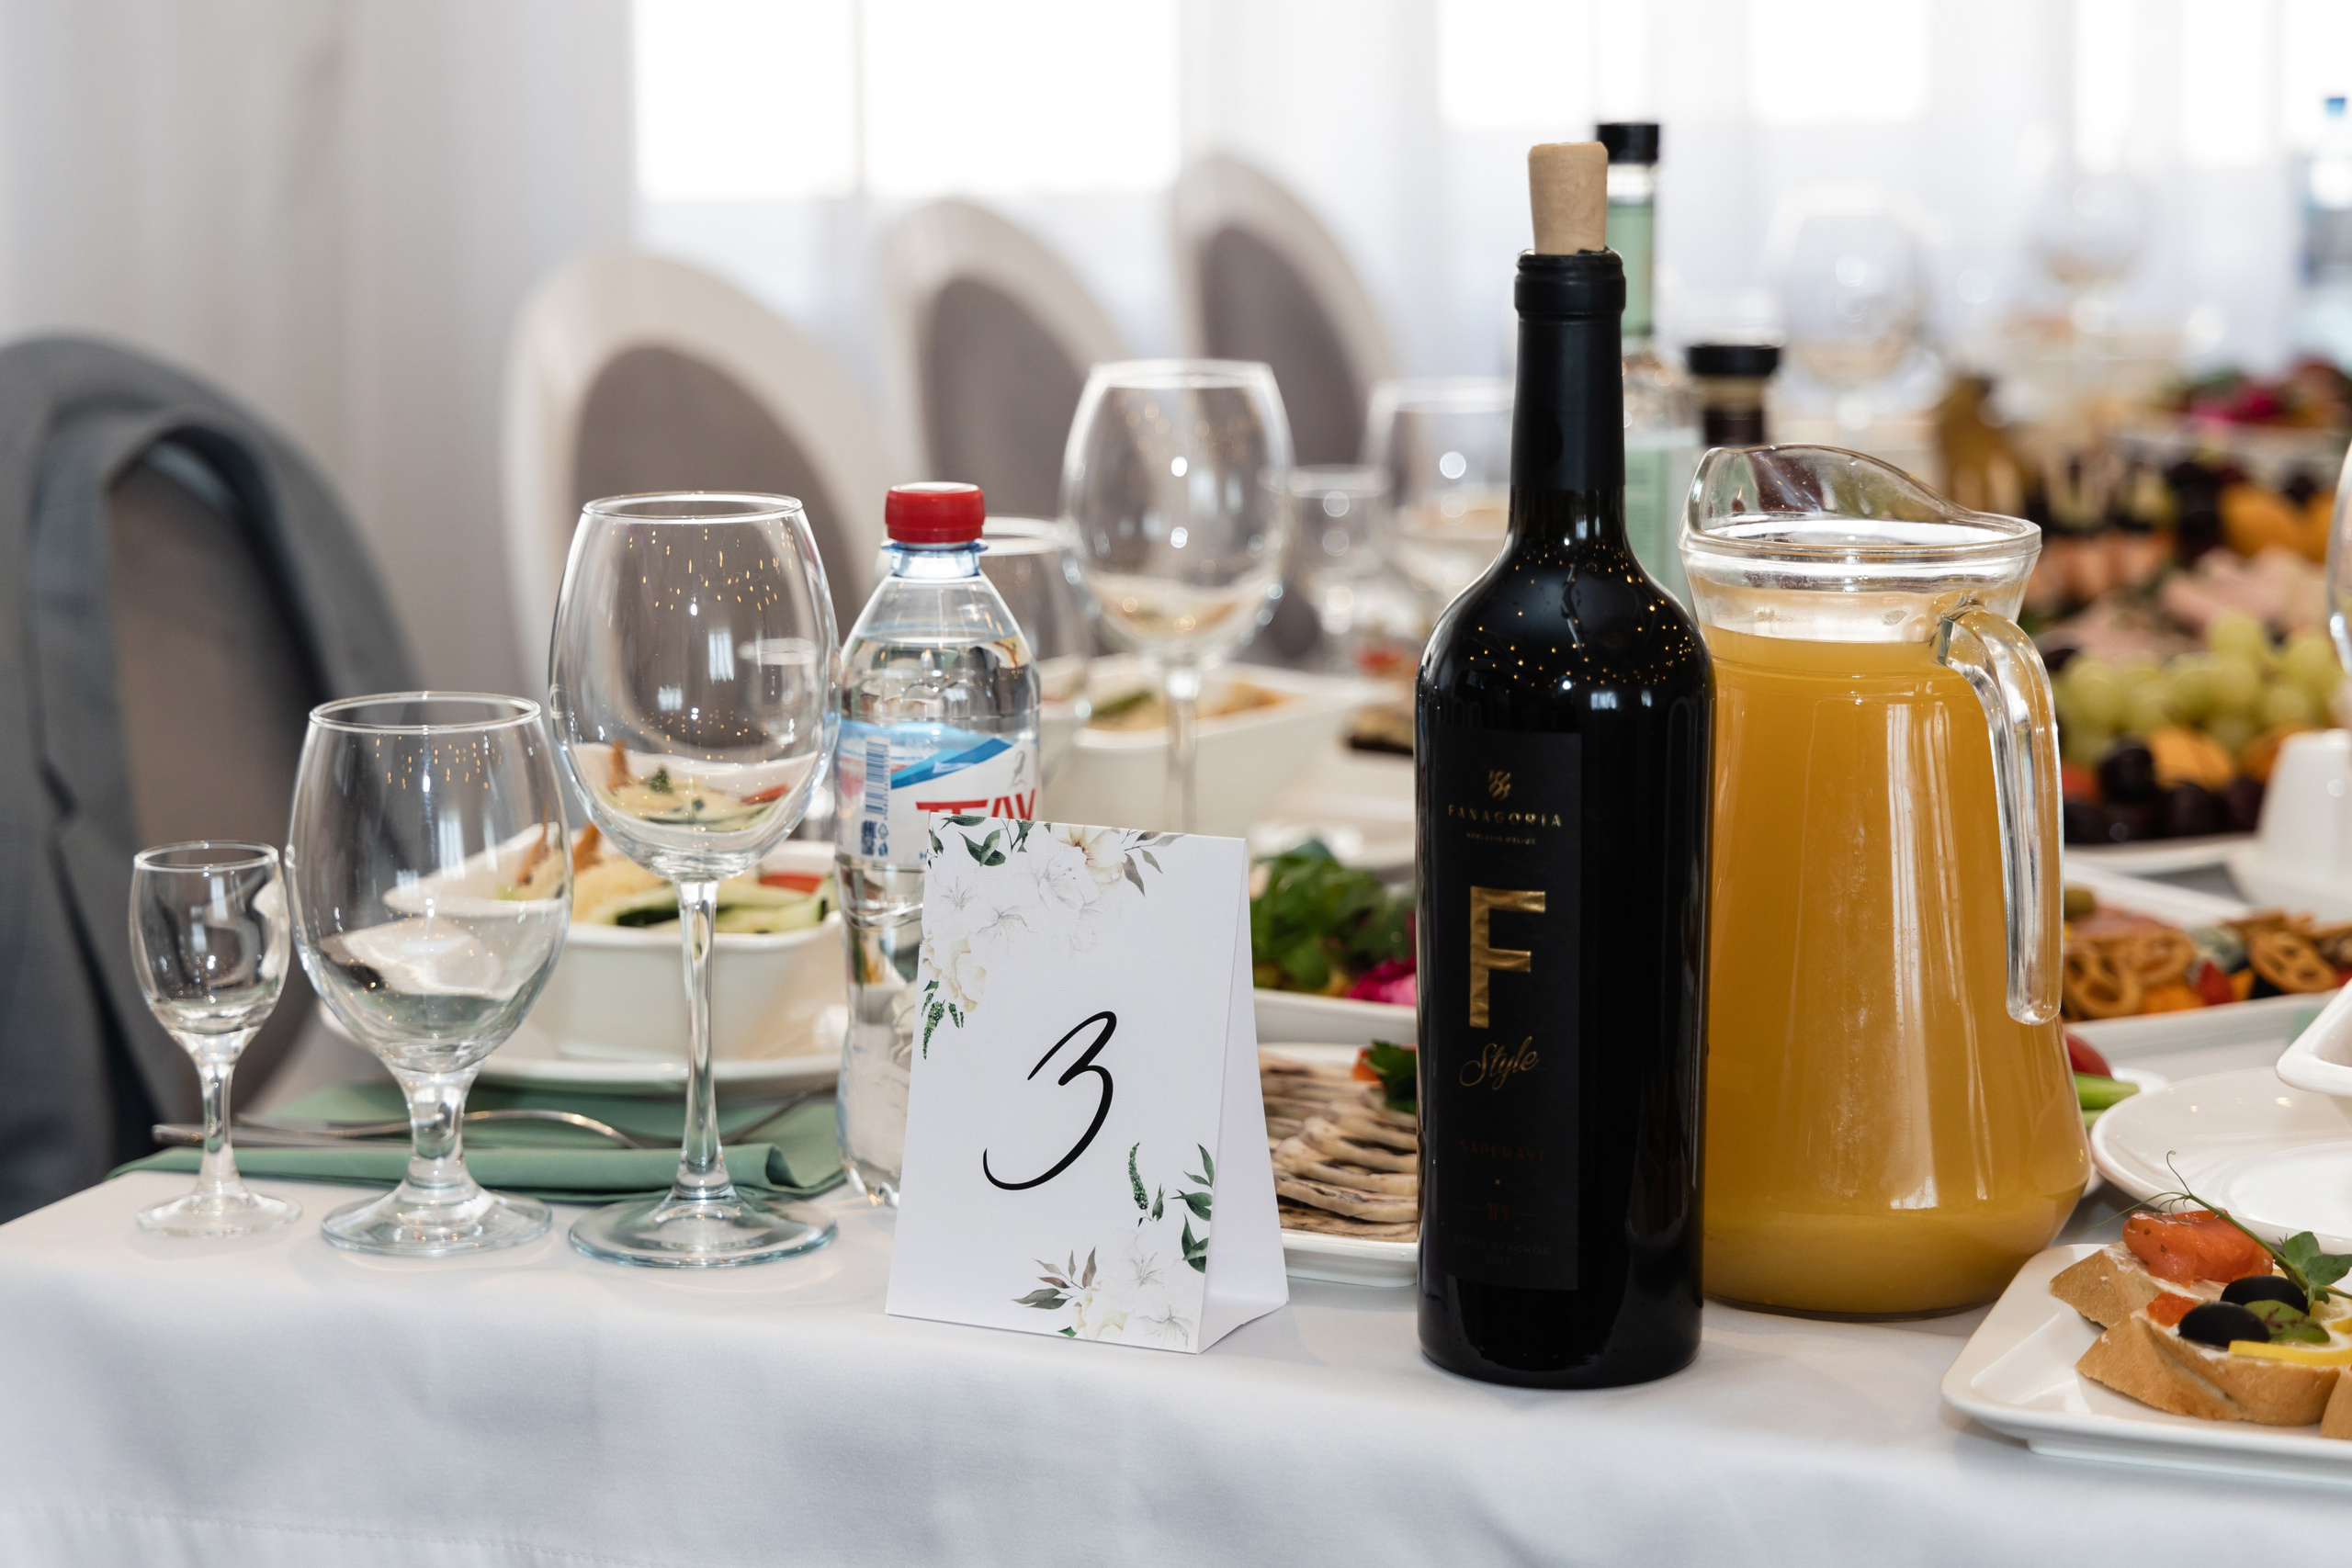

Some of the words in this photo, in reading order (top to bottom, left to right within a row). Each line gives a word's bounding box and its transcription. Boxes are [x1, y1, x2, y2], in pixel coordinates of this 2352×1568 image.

[1448, 803, 1562, 829] FANAGORIA
[1469, 885, 1546, 1029] F
[1459, 1034, 1539, 1091] Style
[983, 1010, 1117, 1190] 3
[1459, 1138, 1544, 1163] SAPERAVI
